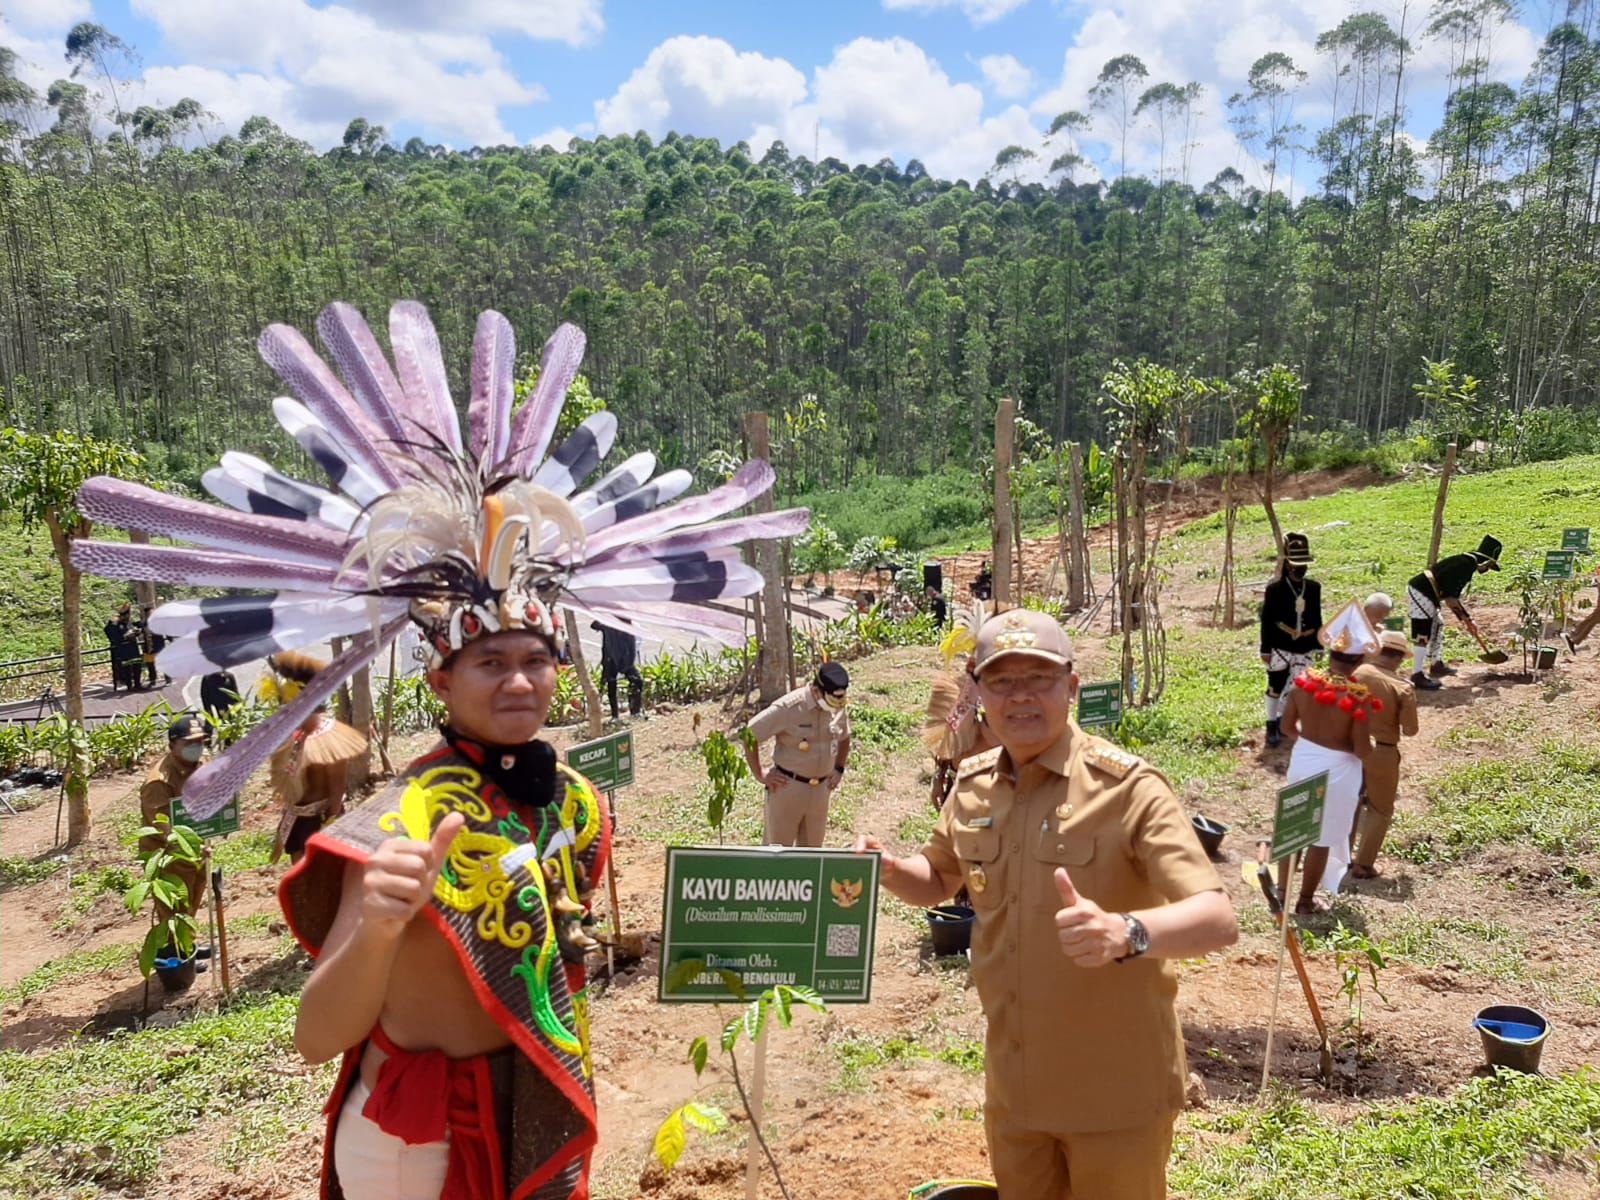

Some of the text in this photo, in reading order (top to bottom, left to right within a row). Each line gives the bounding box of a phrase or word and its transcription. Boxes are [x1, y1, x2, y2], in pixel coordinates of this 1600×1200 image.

[579, 748, 607, 763] KECAPI
[682, 878, 813, 902] KAYU BAWANG
[685, 906, 807, 925] (Disoxilum mollissimum)
[706, 953, 747, 968] Ditanam
[748, 953, 772, 967] Oleh
[743, 972, 796, 985] BENGKULU
